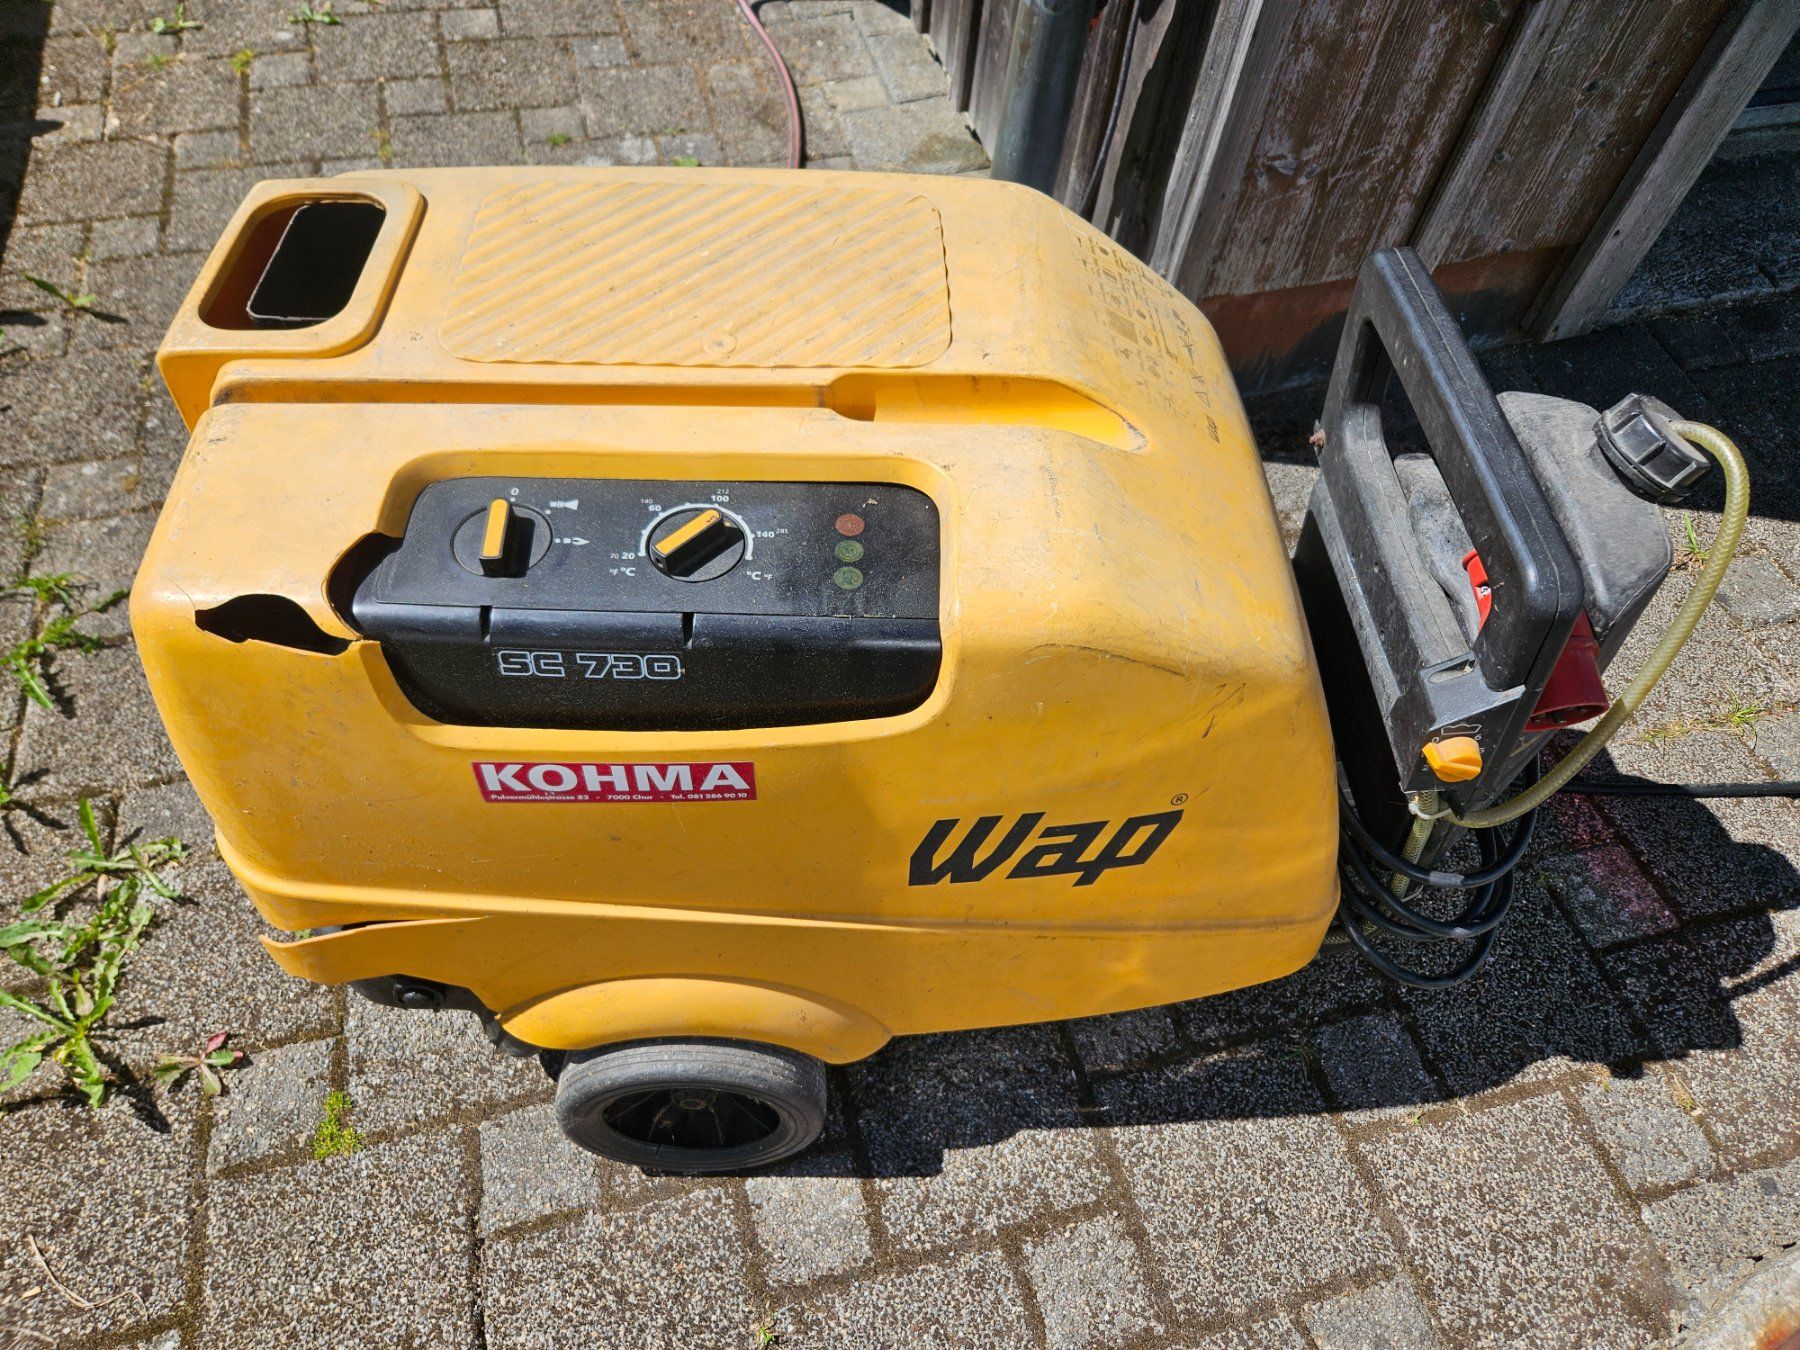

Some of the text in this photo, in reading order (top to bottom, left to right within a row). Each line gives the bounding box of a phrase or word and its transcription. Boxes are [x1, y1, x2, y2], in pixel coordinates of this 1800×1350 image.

[510, 487, 519, 496] 0
[648, 504, 661, 512] 60
[621, 552, 635, 560] 20
[498, 651, 682, 680] SC 730
[480, 764, 750, 793] KOHMA
[908, 809, 1184, 887] Wap
